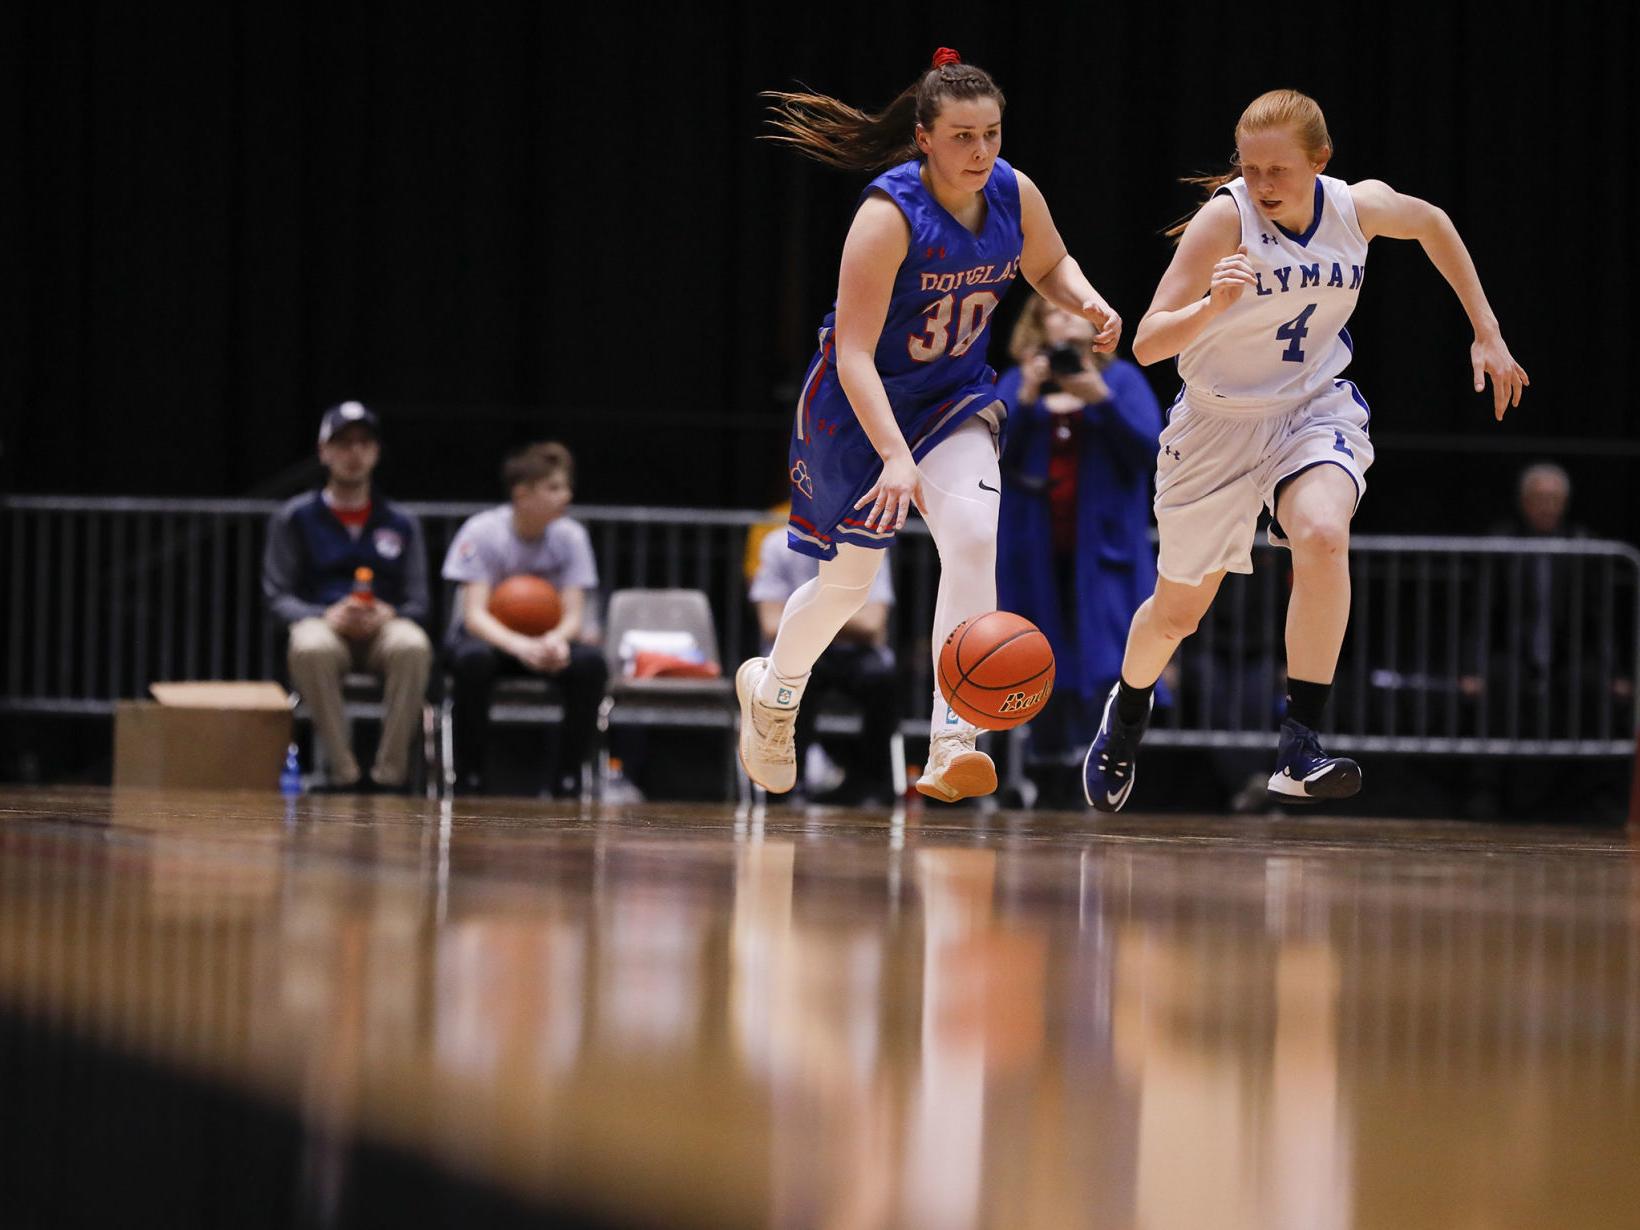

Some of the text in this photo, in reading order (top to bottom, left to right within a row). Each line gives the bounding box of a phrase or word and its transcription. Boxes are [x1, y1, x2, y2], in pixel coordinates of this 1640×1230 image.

[1255, 262, 1364, 296] LYMAN
[907, 290, 999, 362] 30
[1275, 303, 1318, 363] 4
[1333, 430, 1355, 460] L
